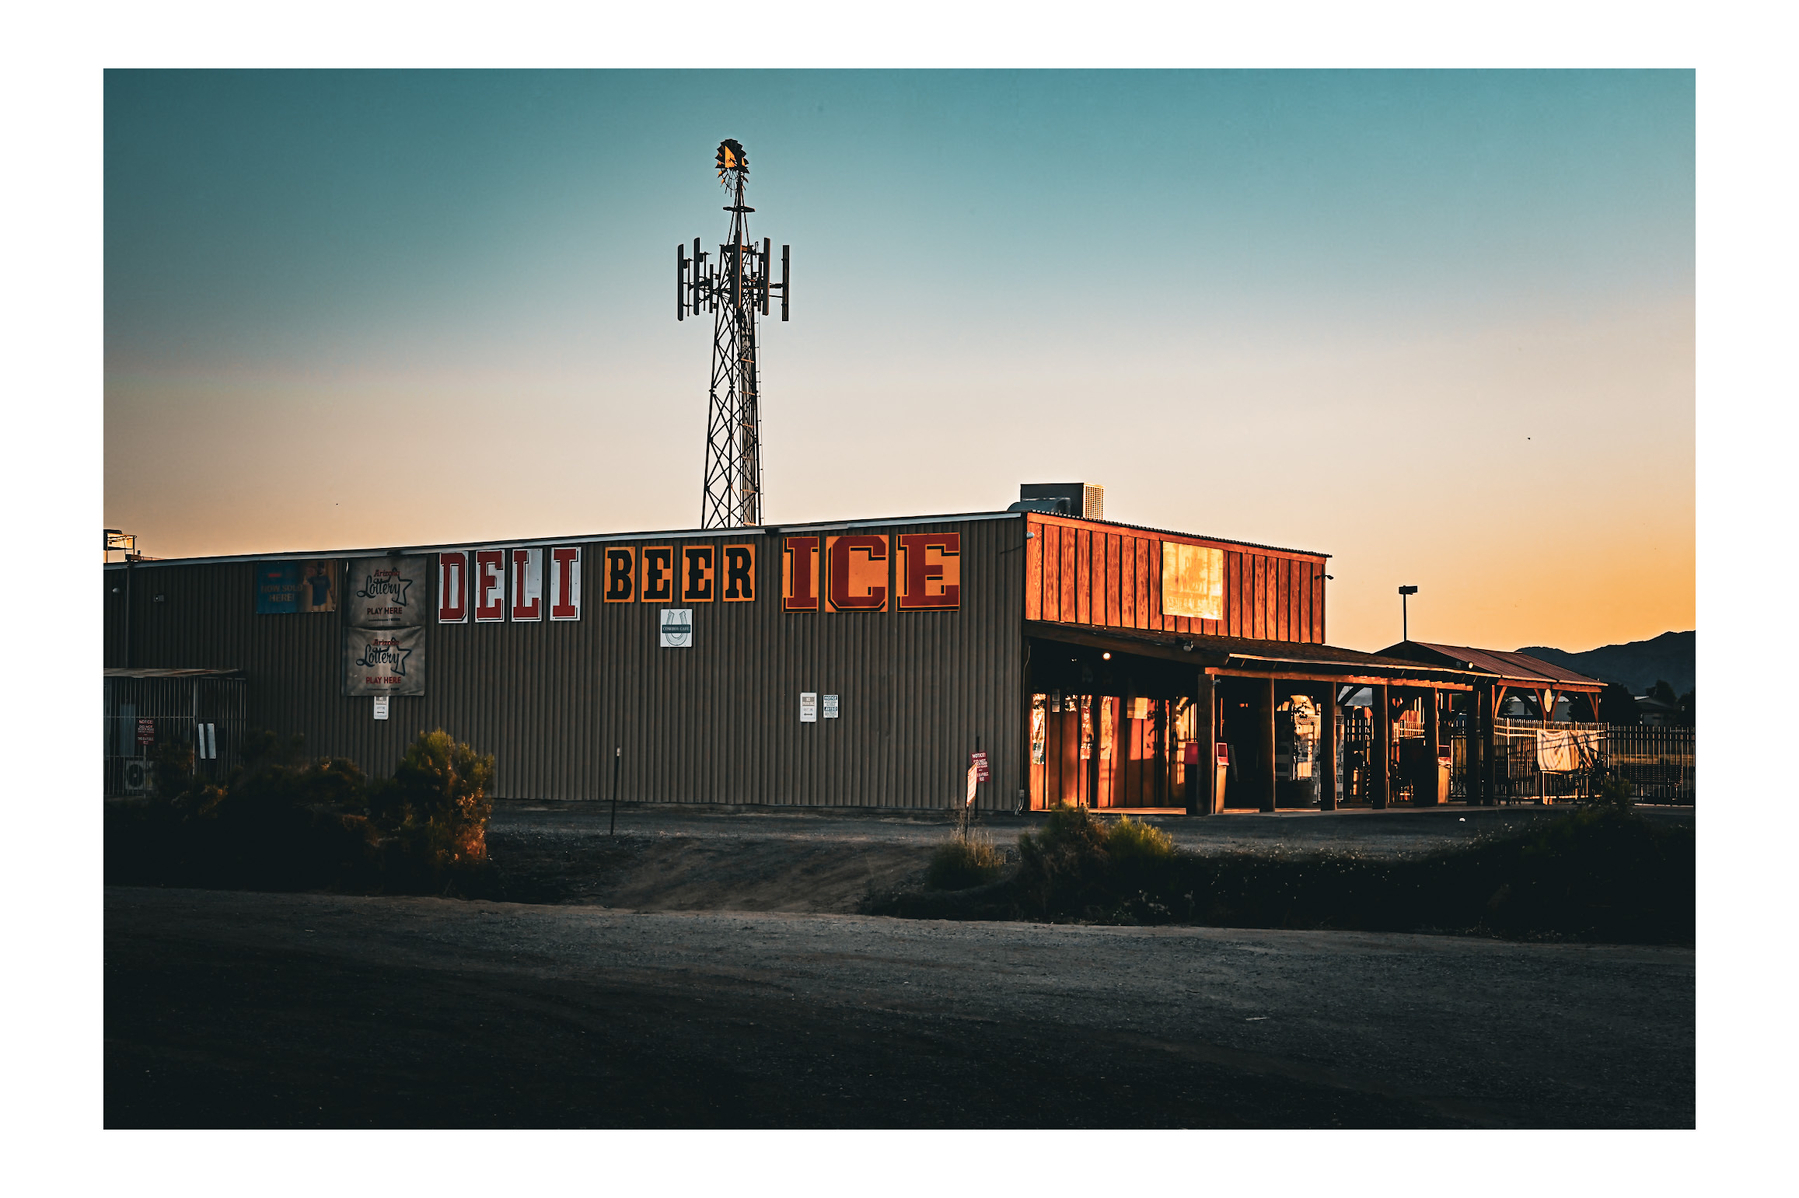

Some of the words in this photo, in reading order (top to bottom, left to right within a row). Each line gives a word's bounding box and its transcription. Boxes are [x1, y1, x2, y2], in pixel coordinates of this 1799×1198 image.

[439, 548, 578, 621] DELI
[606, 547, 753, 600] BEER
[784, 533, 960, 611] ICE
[282, 584, 303, 592] SOLD
[357, 575, 405, 604] Lottery
[367, 607, 383, 615] PLAY
[384, 606, 403, 615] HERE
[356, 644, 404, 673] Lottery
